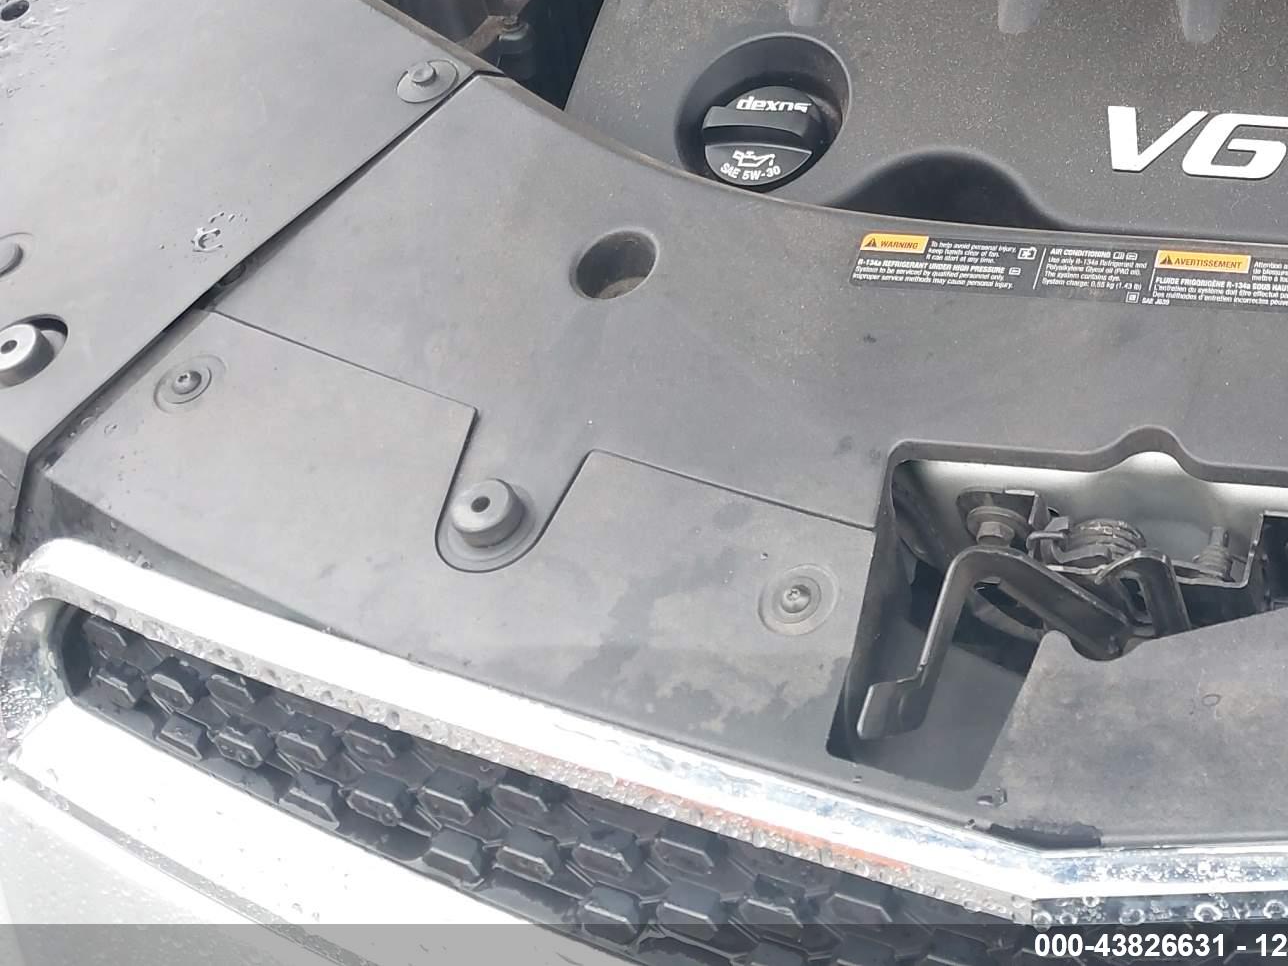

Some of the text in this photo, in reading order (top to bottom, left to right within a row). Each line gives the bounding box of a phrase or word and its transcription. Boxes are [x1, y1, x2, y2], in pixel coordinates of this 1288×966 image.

[721, 163, 781, 180] SAE 5W-30
[880, 241, 918, 249] WARNING
[939, 241, 952, 249] help
[972, 243, 998, 252] personal
[999, 245, 1016, 253] injury.
[1064, 249, 1111, 258] CONDITIONING
[883, 260, 928, 269] REFRIGERANT
[971, 265, 1005, 273] PRESSURE
[1061, 257, 1074, 265] only
[1174, 258, 1242, 269] AVERTISSEMENT
[1254, 261, 1281, 269] Attention
[856, 266, 878, 274] System
[932, 270, 957, 278] qualified
[958, 272, 988, 280] personnel
[1057, 271, 1079, 280] system
[853, 273, 880, 282] Improper
[967, 280, 994, 288] personal
[995, 281, 1013, 289] injury.
[1042, 278, 1065, 287] System
[1106, 281, 1114, 290] kg
[1116, 282, 1132, 291] (1.43
[1180, 278, 1225, 287] FRIGORIGÈNE
[1252, 282, 1270, 290] SOUS
[1234, 296, 1268, 304] incorrectes
